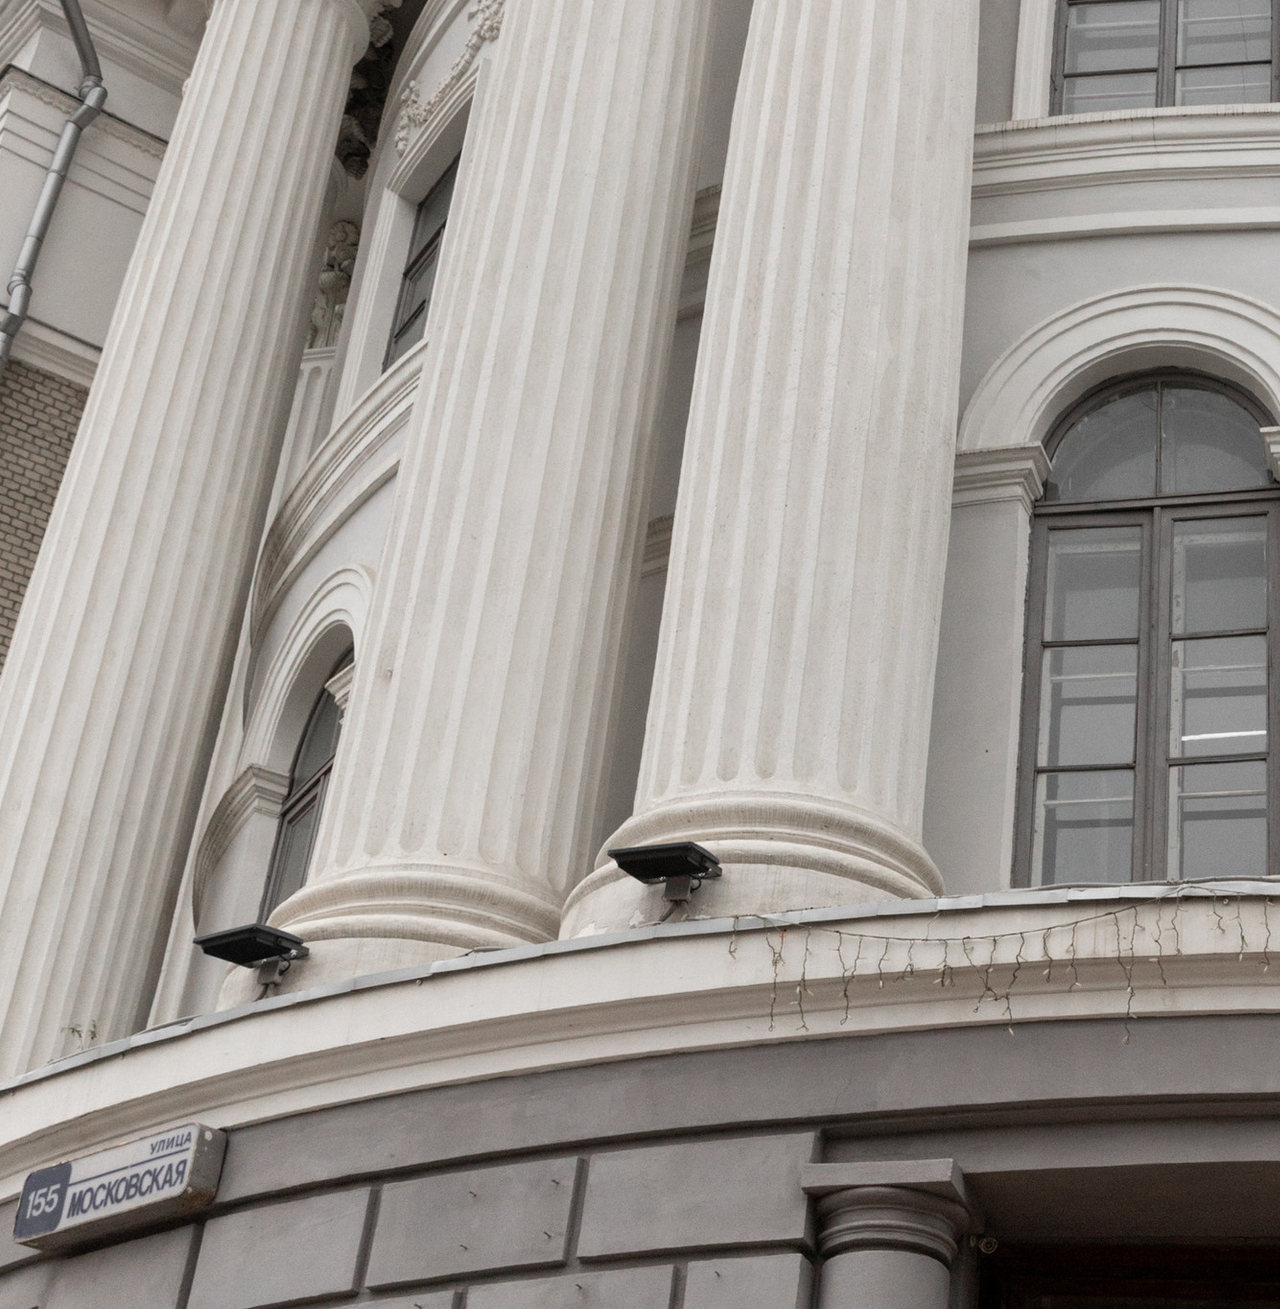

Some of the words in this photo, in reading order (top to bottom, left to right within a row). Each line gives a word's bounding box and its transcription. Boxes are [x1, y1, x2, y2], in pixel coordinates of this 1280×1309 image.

[150, 1131, 192, 1155] УЛИЦА
[26, 1183, 61, 1219] 155
[67, 1158, 188, 1219] МОСКОВСКАЯ
